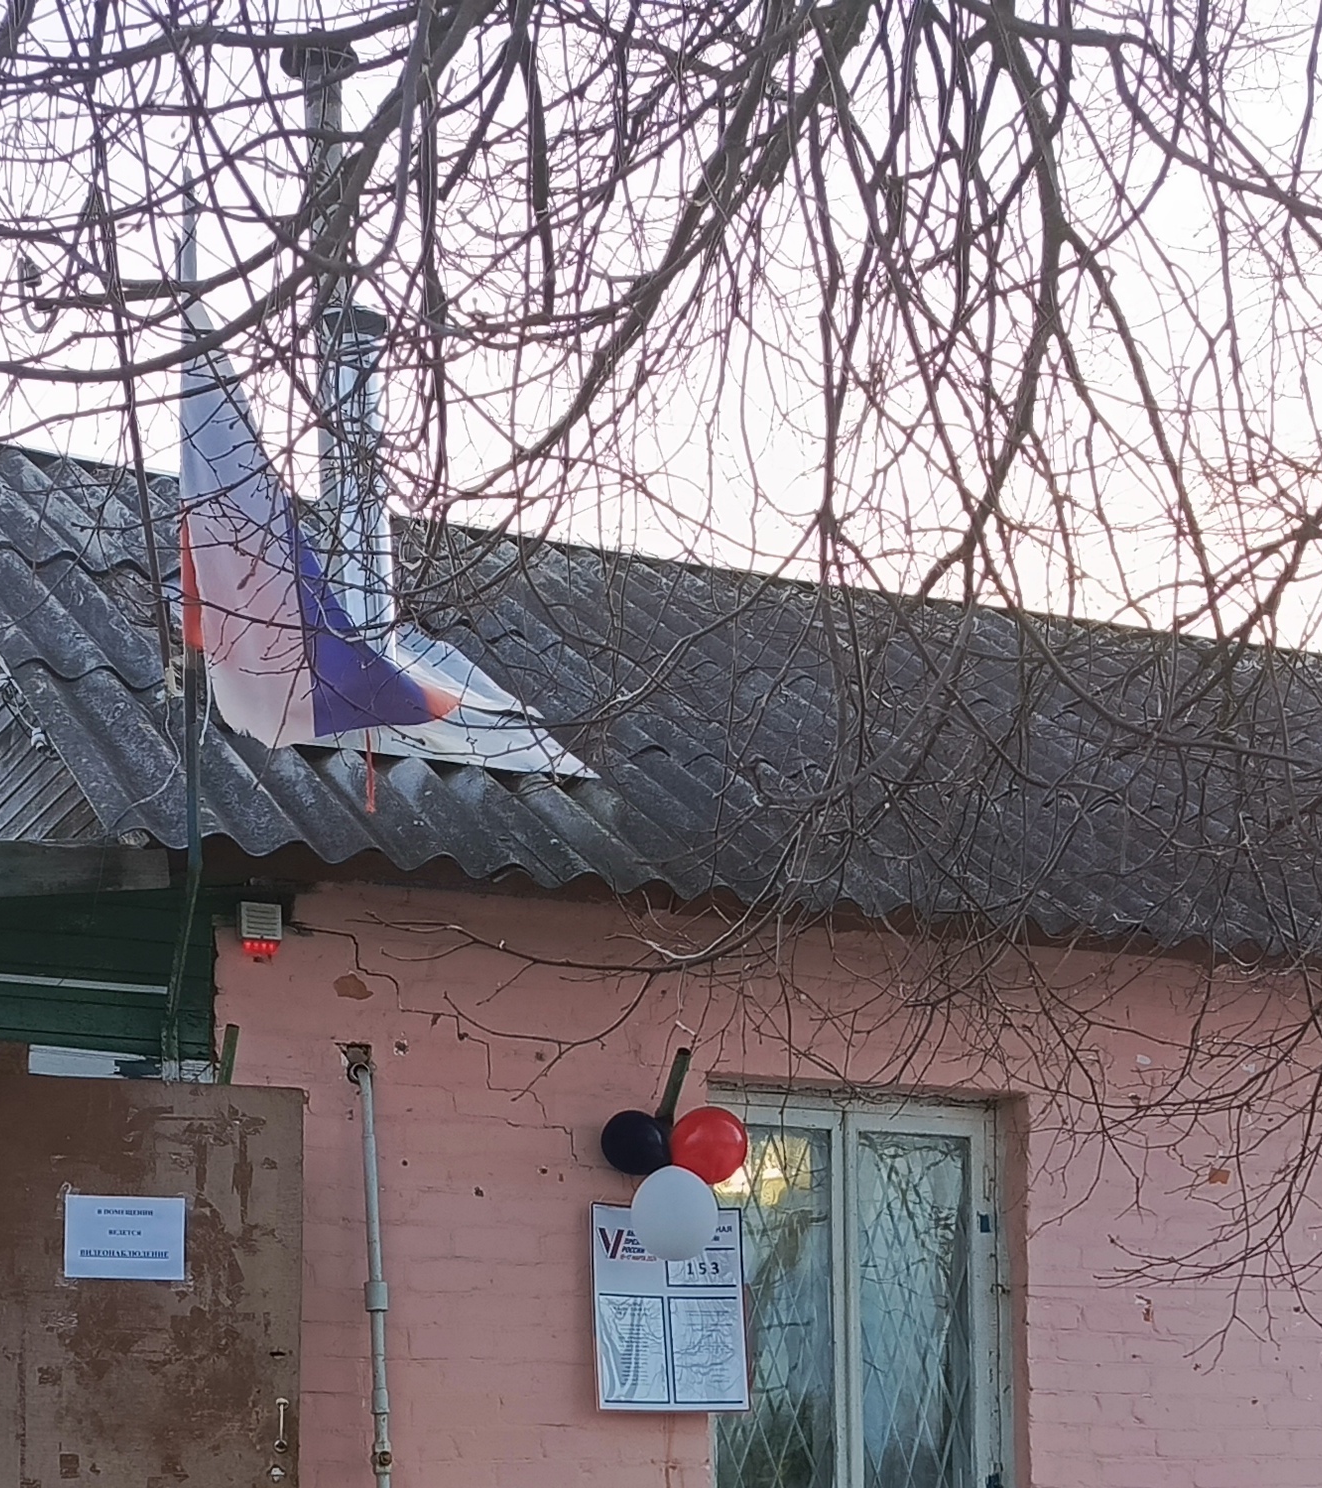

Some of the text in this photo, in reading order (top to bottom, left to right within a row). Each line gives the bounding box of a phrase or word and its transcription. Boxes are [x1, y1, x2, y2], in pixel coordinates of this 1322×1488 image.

[103, 1209, 154, 1217] ПОМЕЩЕНИИ
[108, 1229, 142, 1237] ВЕДЕТСЯ
[79, 1249, 169, 1259] ВИДЕОНАБЛЮДЕНИЕ
